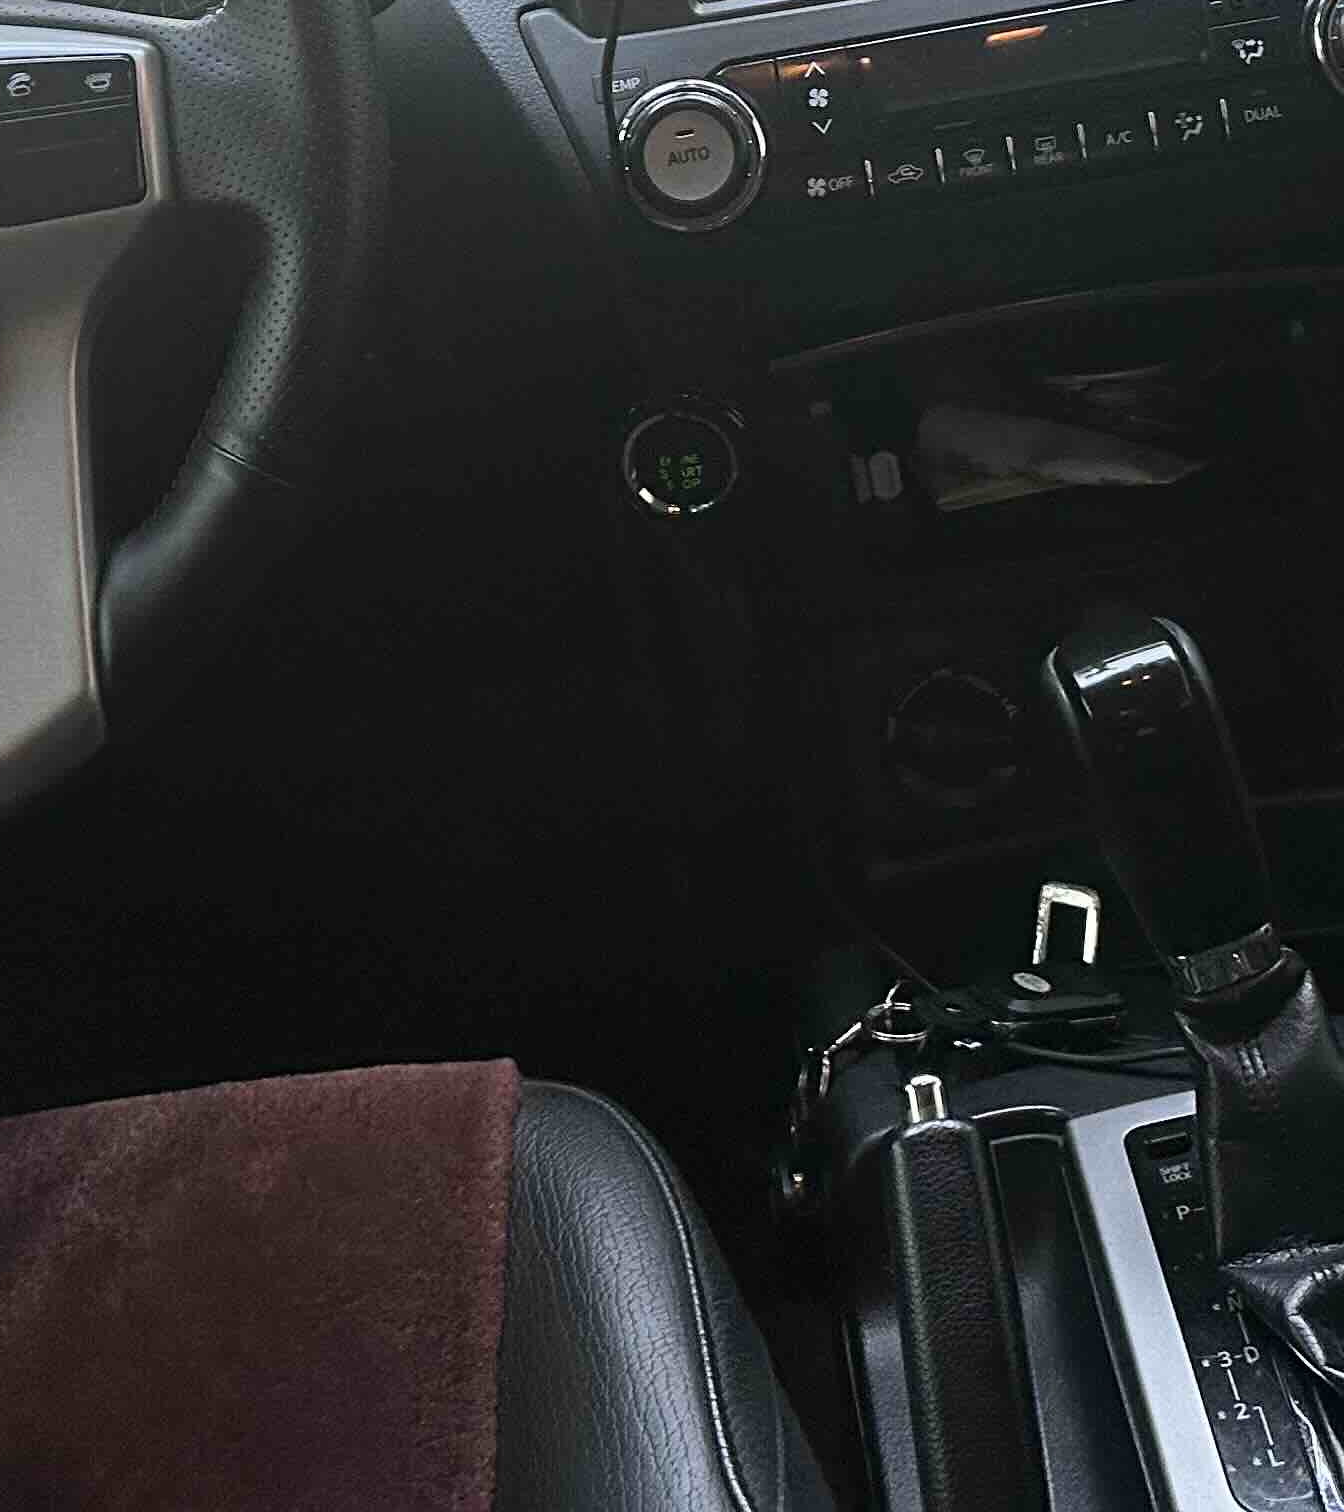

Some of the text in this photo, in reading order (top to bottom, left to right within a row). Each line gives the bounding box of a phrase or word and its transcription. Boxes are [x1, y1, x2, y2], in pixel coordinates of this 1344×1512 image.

[611, 76, 641, 94] EMP
[1242, 104, 1283, 124] DUAL
[1105, 128, 1133, 146] A/C
[667, 146, 710, 168] AUTO
[827, 175, 856, 192] OFF
[1175, 1205, 1191, 1221] P
[1216, 1345, 1260, 1368] 3 D
[1233, 1403, 1251, 1420] 2
[1266, 1449, 1286, 1467] L
